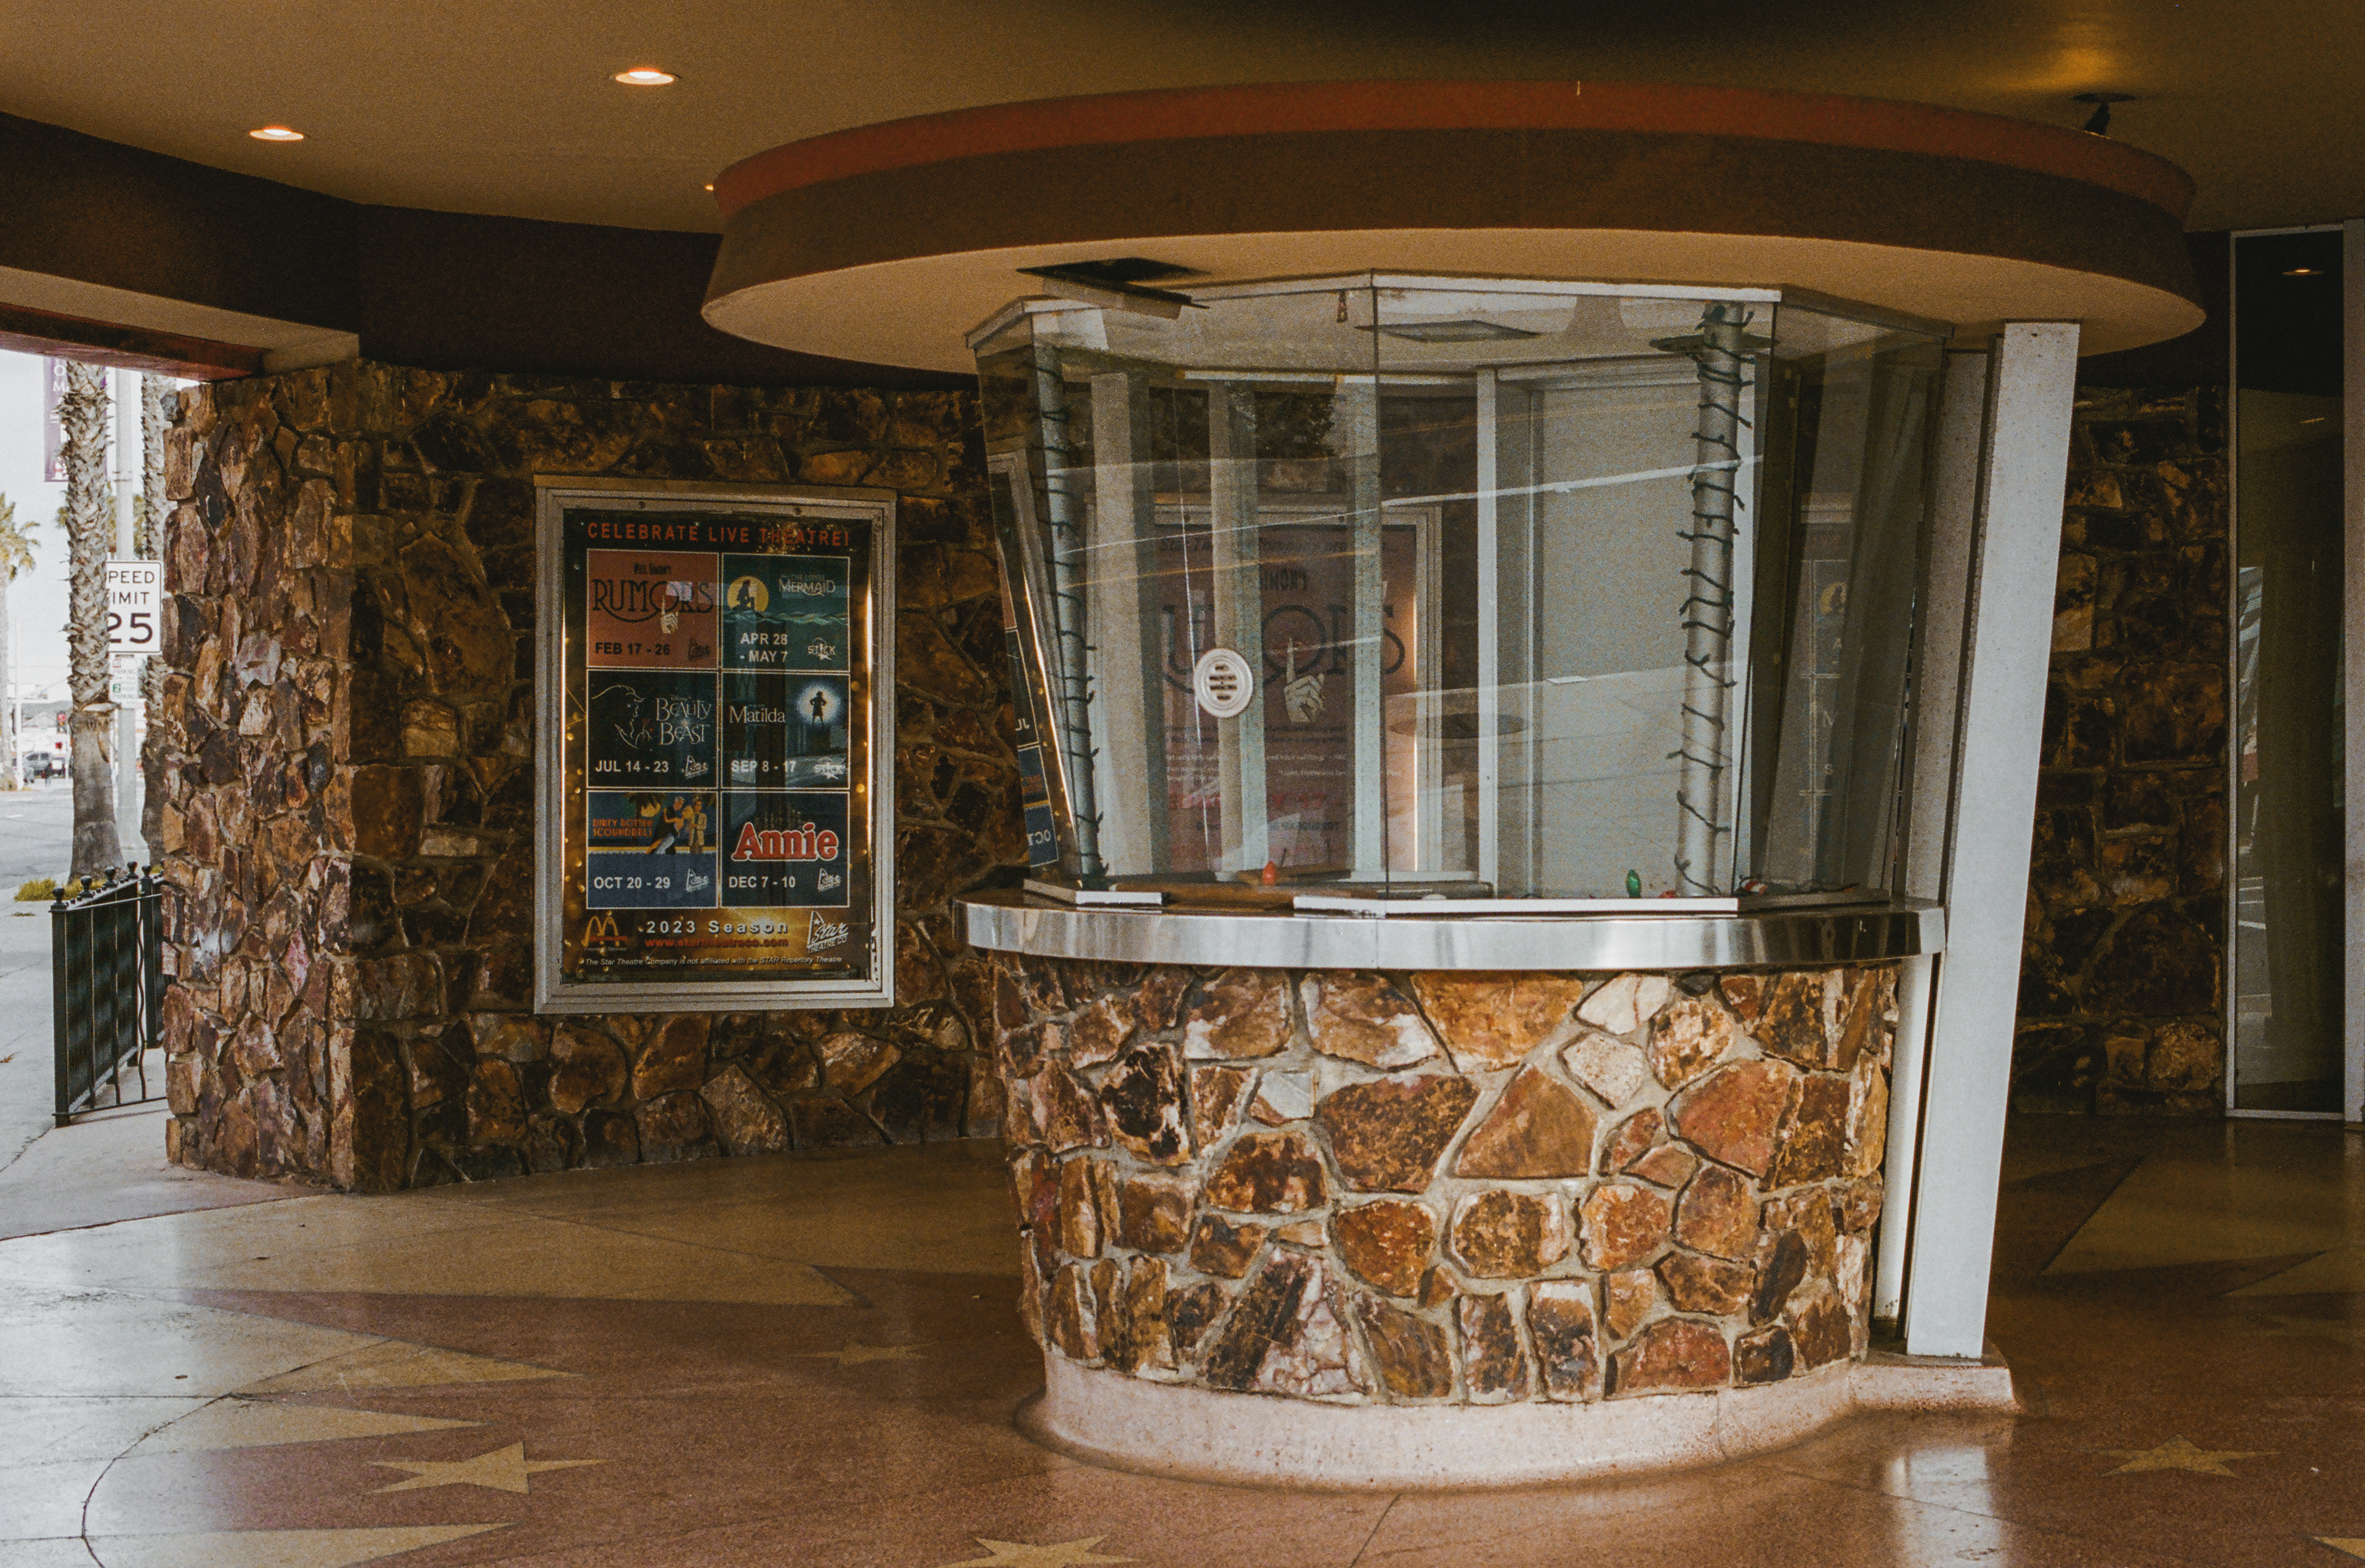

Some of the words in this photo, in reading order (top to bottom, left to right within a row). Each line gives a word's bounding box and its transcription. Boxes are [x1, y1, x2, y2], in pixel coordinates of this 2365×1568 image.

[588, 522, 698, 541] CELEBRATE
[709, 526, 750, 543] LIVE
[759, 527, 849, 546] THEATRE!
[108, 570, 155, 584] PEED
[110, 591, 150, 604] IMIT
[592, 579, 714, 623] RUMORS
[107, 612, 153, 644] 25
[740, 632, 769, 645] APR
[773, 633, 788, 645] 28
[595, 642, 623, 655] FEB
[627, 643, 642, 655] 17
[654, 644, 671, 655] 26
[748, 650, 777, 663] MAY
[781, 650, 788, 663] 7
[730, 706, 785, 724] Matilda
[595, 760, 621, 772] JUL
[626, 760, 641, 772] 14
[653, 761, 669, 772] 23
[731, 759, 758, 772] SEP
[762, 761, 769, 772] 8
[783, 760, 797, 773] 17
[593, 828, 653, 837] SCOUNDRELS
[731, 822, 839, 861] Annie
[594, 876, 623, 889] OCT
[626, 876, 642, 889] 20
[655, 876, 671, 889] 29
[729, 876, 757, 888] DEC
[761, 876, 769, 888] 7
[781, 876, 796, 888] 10
[647, 920, 696, 934] 2023
[708, 920, 788, 934] Season
[811, 921, 849, 944] Star
[808, 938, 836, 954] THEATRE
[645, 958, 678, 966] Company
[700, 956, 730, 964] affiliated
[781, 956, 814, 964] Repertory
